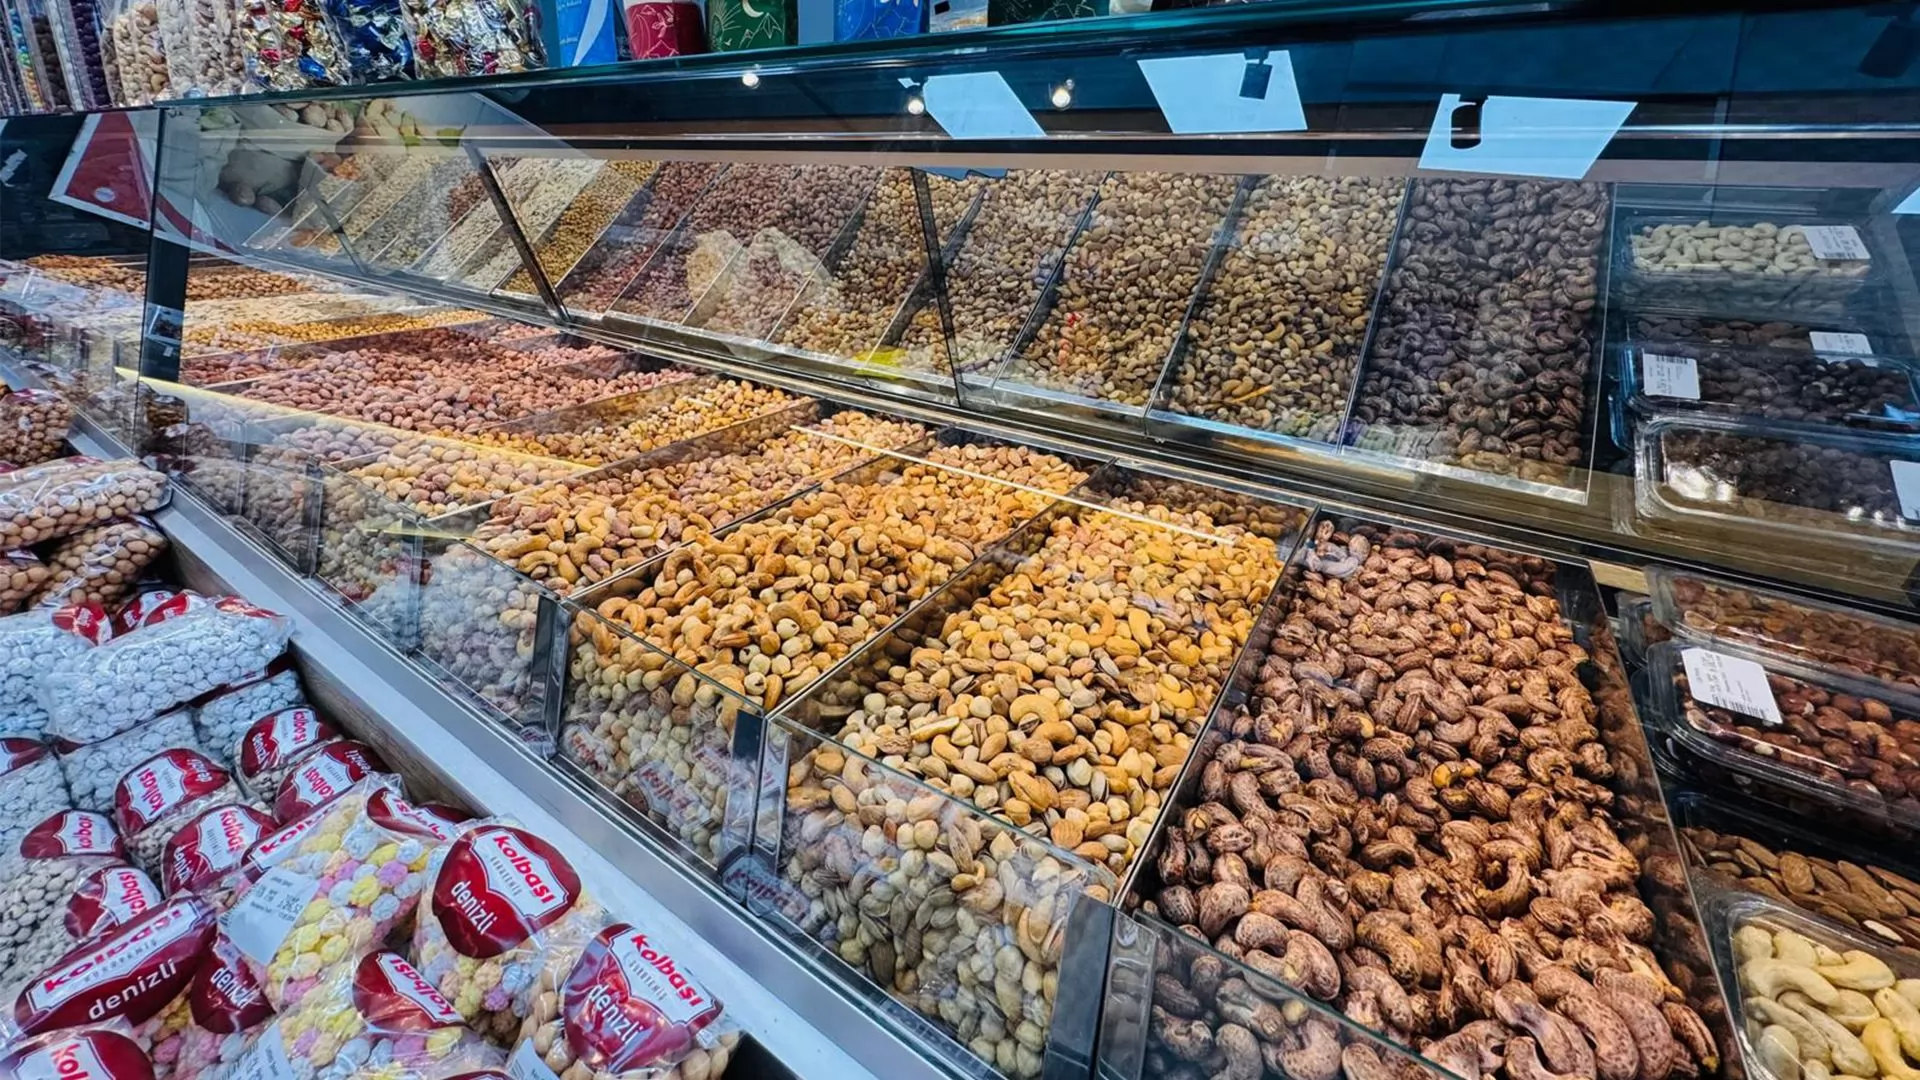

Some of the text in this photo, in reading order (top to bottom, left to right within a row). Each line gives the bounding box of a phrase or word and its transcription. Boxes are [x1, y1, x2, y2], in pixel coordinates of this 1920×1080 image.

[451, 880, 498, 935] denizli
[88, 959, 177, 1020] denizli
[589, 983, 645, 1042] denizli
